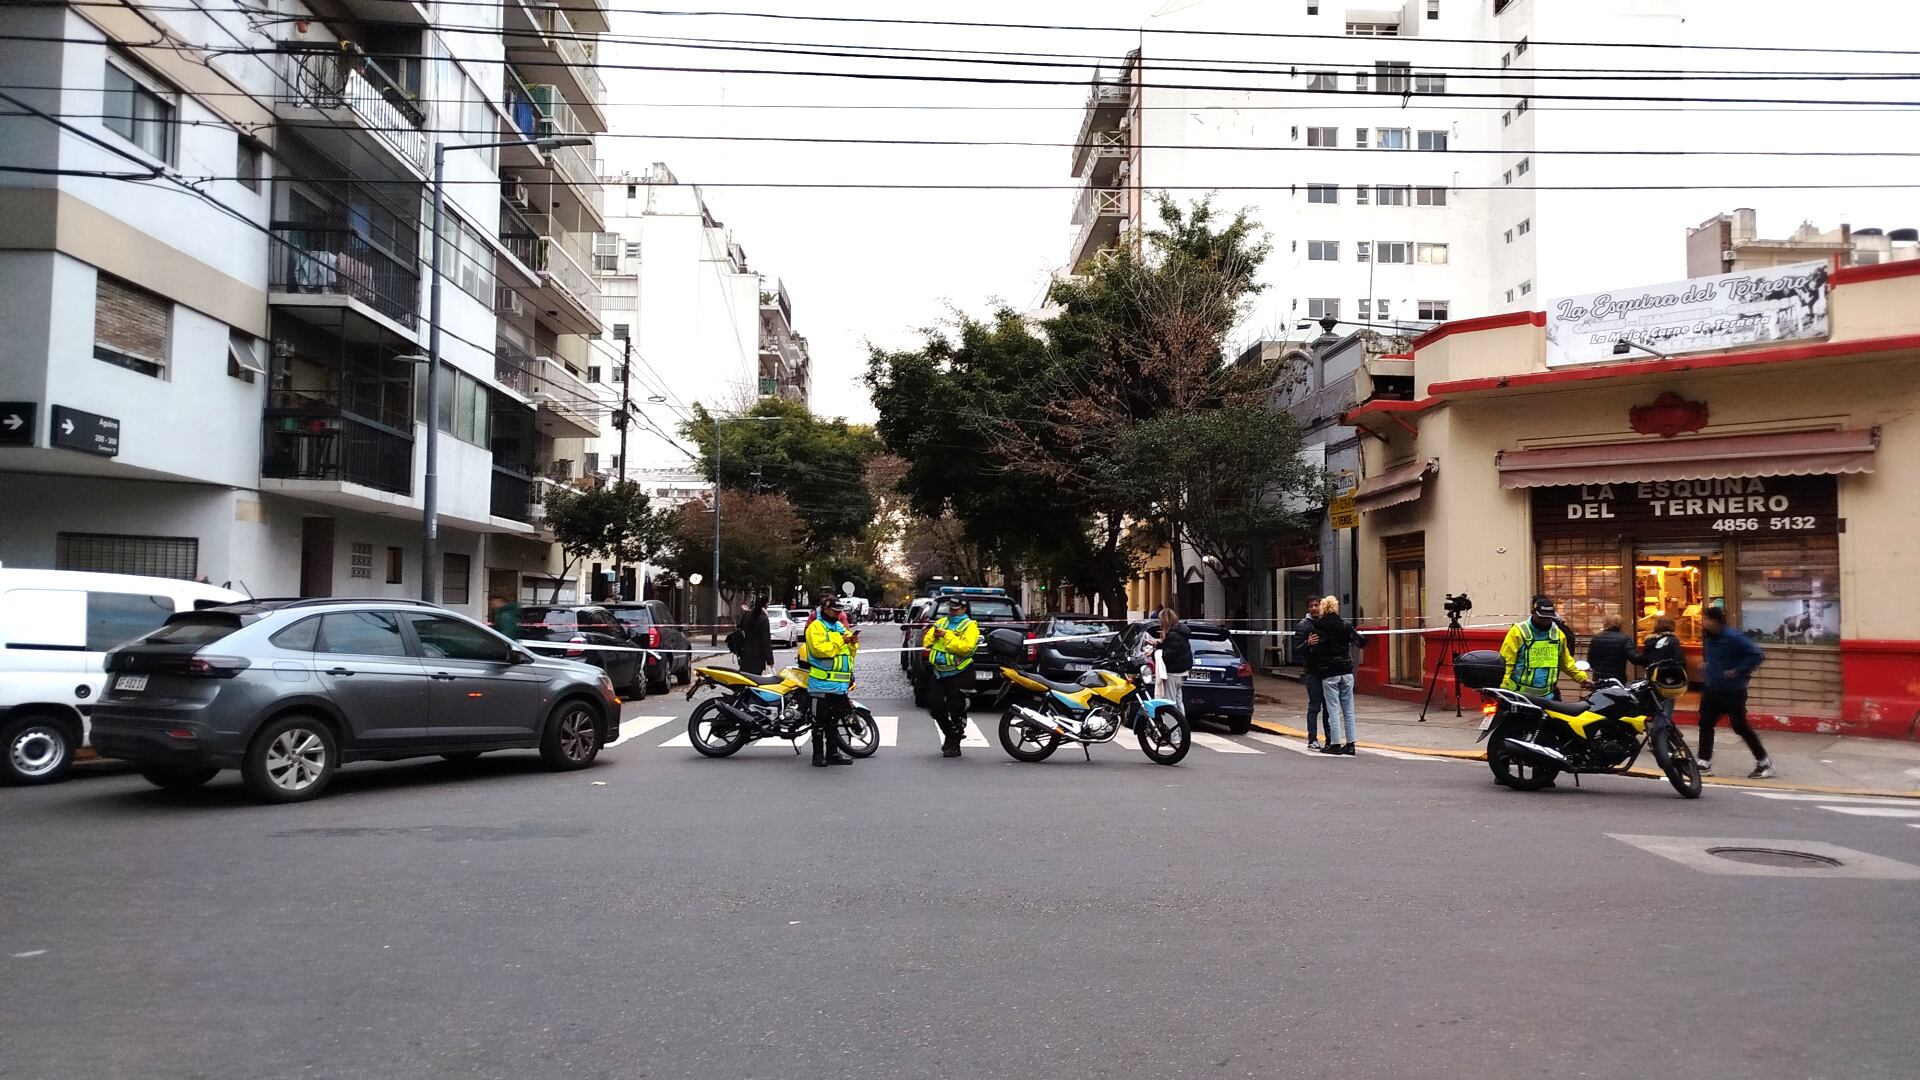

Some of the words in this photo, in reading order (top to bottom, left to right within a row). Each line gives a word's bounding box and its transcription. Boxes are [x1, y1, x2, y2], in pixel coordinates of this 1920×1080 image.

[1557, 299, 1587, 322] La
[1591, 294, 1679, 320] Esquina
[1681, 285, 1717, 305] del
[1719, 276, 1809, 302] Ternero
[1590, 333, 1606, 345] La
[1650, 325, 1691, 338] Carne
[1693, 321, 1711, 333] de
[1714, 315, 1771, 331] Ternera
[1581, 484, 1615, 501] LA
[1637, 477, 1767, 499] ESQUINA
[1567, 503, 1615, 519] DEL
[1650, 495, 1789, 516] TERNERO
[1712, 518, 1759, 531] 4856
[1769, 516, 1816, 530] 5132
